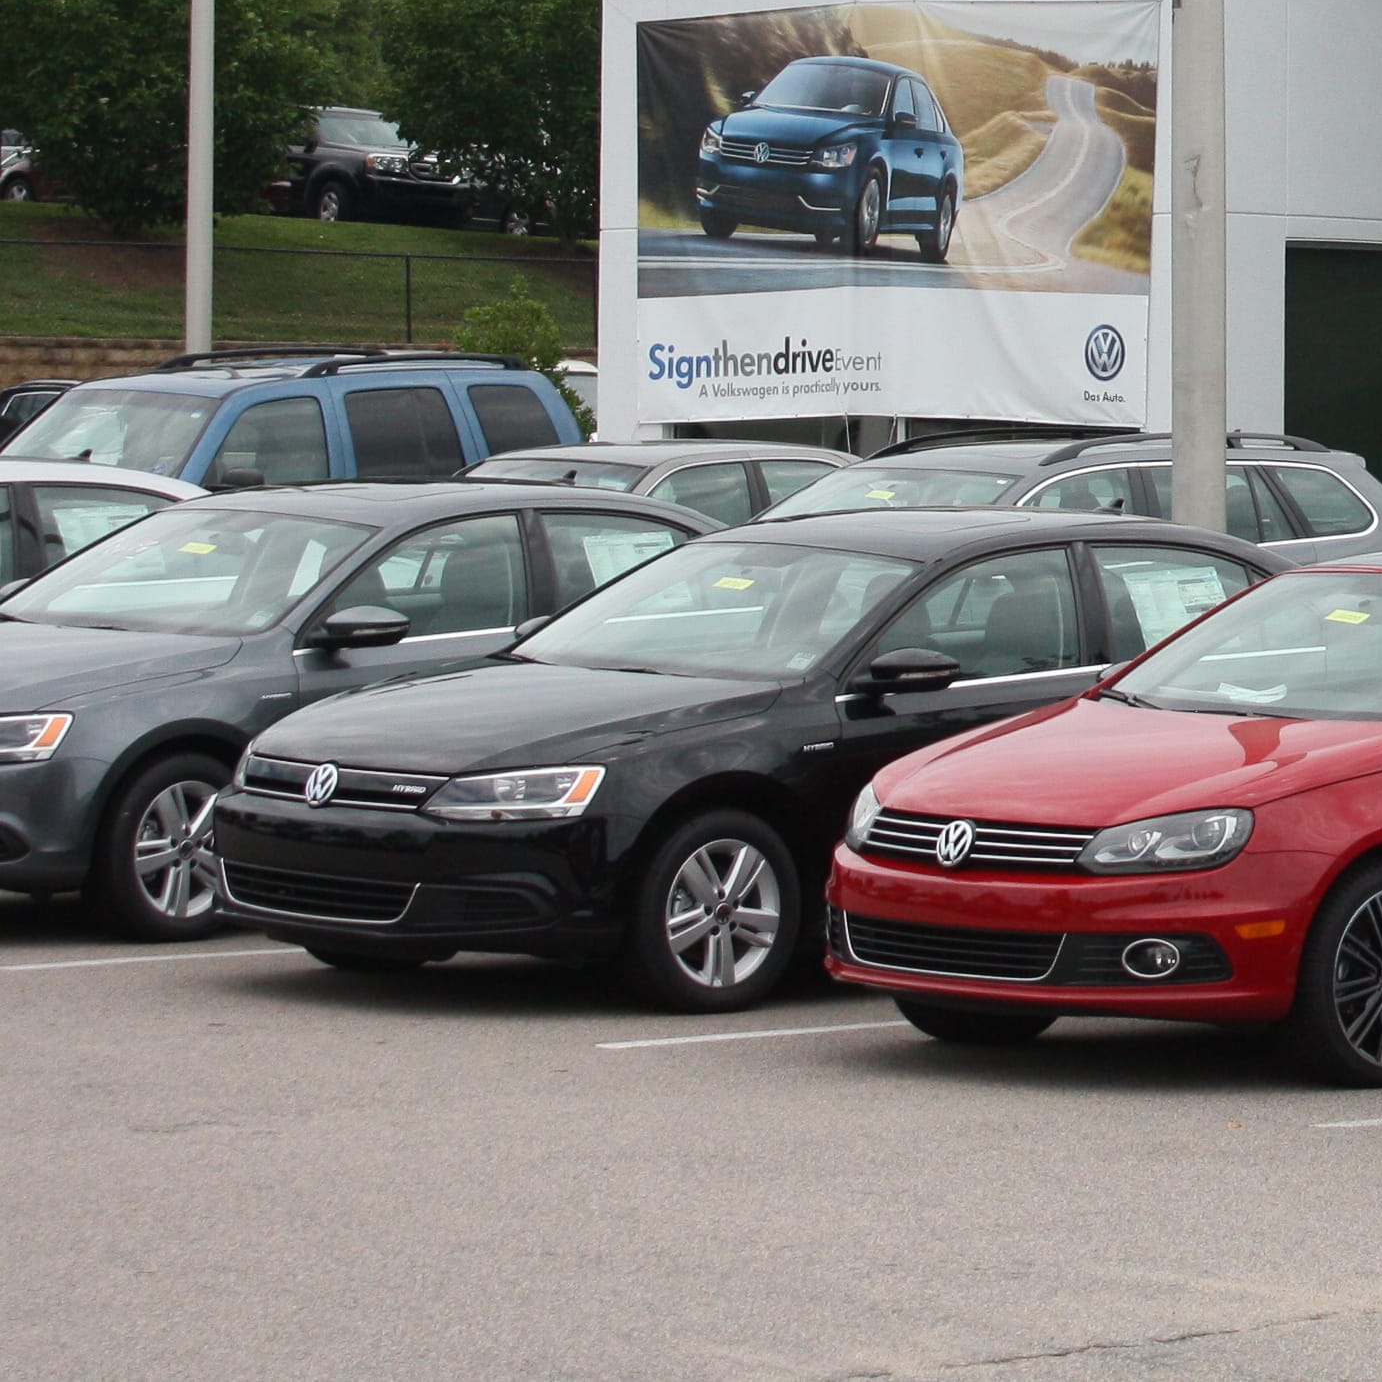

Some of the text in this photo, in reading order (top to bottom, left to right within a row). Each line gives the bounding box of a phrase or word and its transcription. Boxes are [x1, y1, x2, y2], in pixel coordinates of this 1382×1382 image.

[1087, 327, 1122, 378] VW
[699, 378, 882, 400] A Volkswagen is practically yours.
[1084, 390, 1126, 402] Das Auto.
[306, 763, 338, 806] VW
[936, 820, 973, 865] VW
